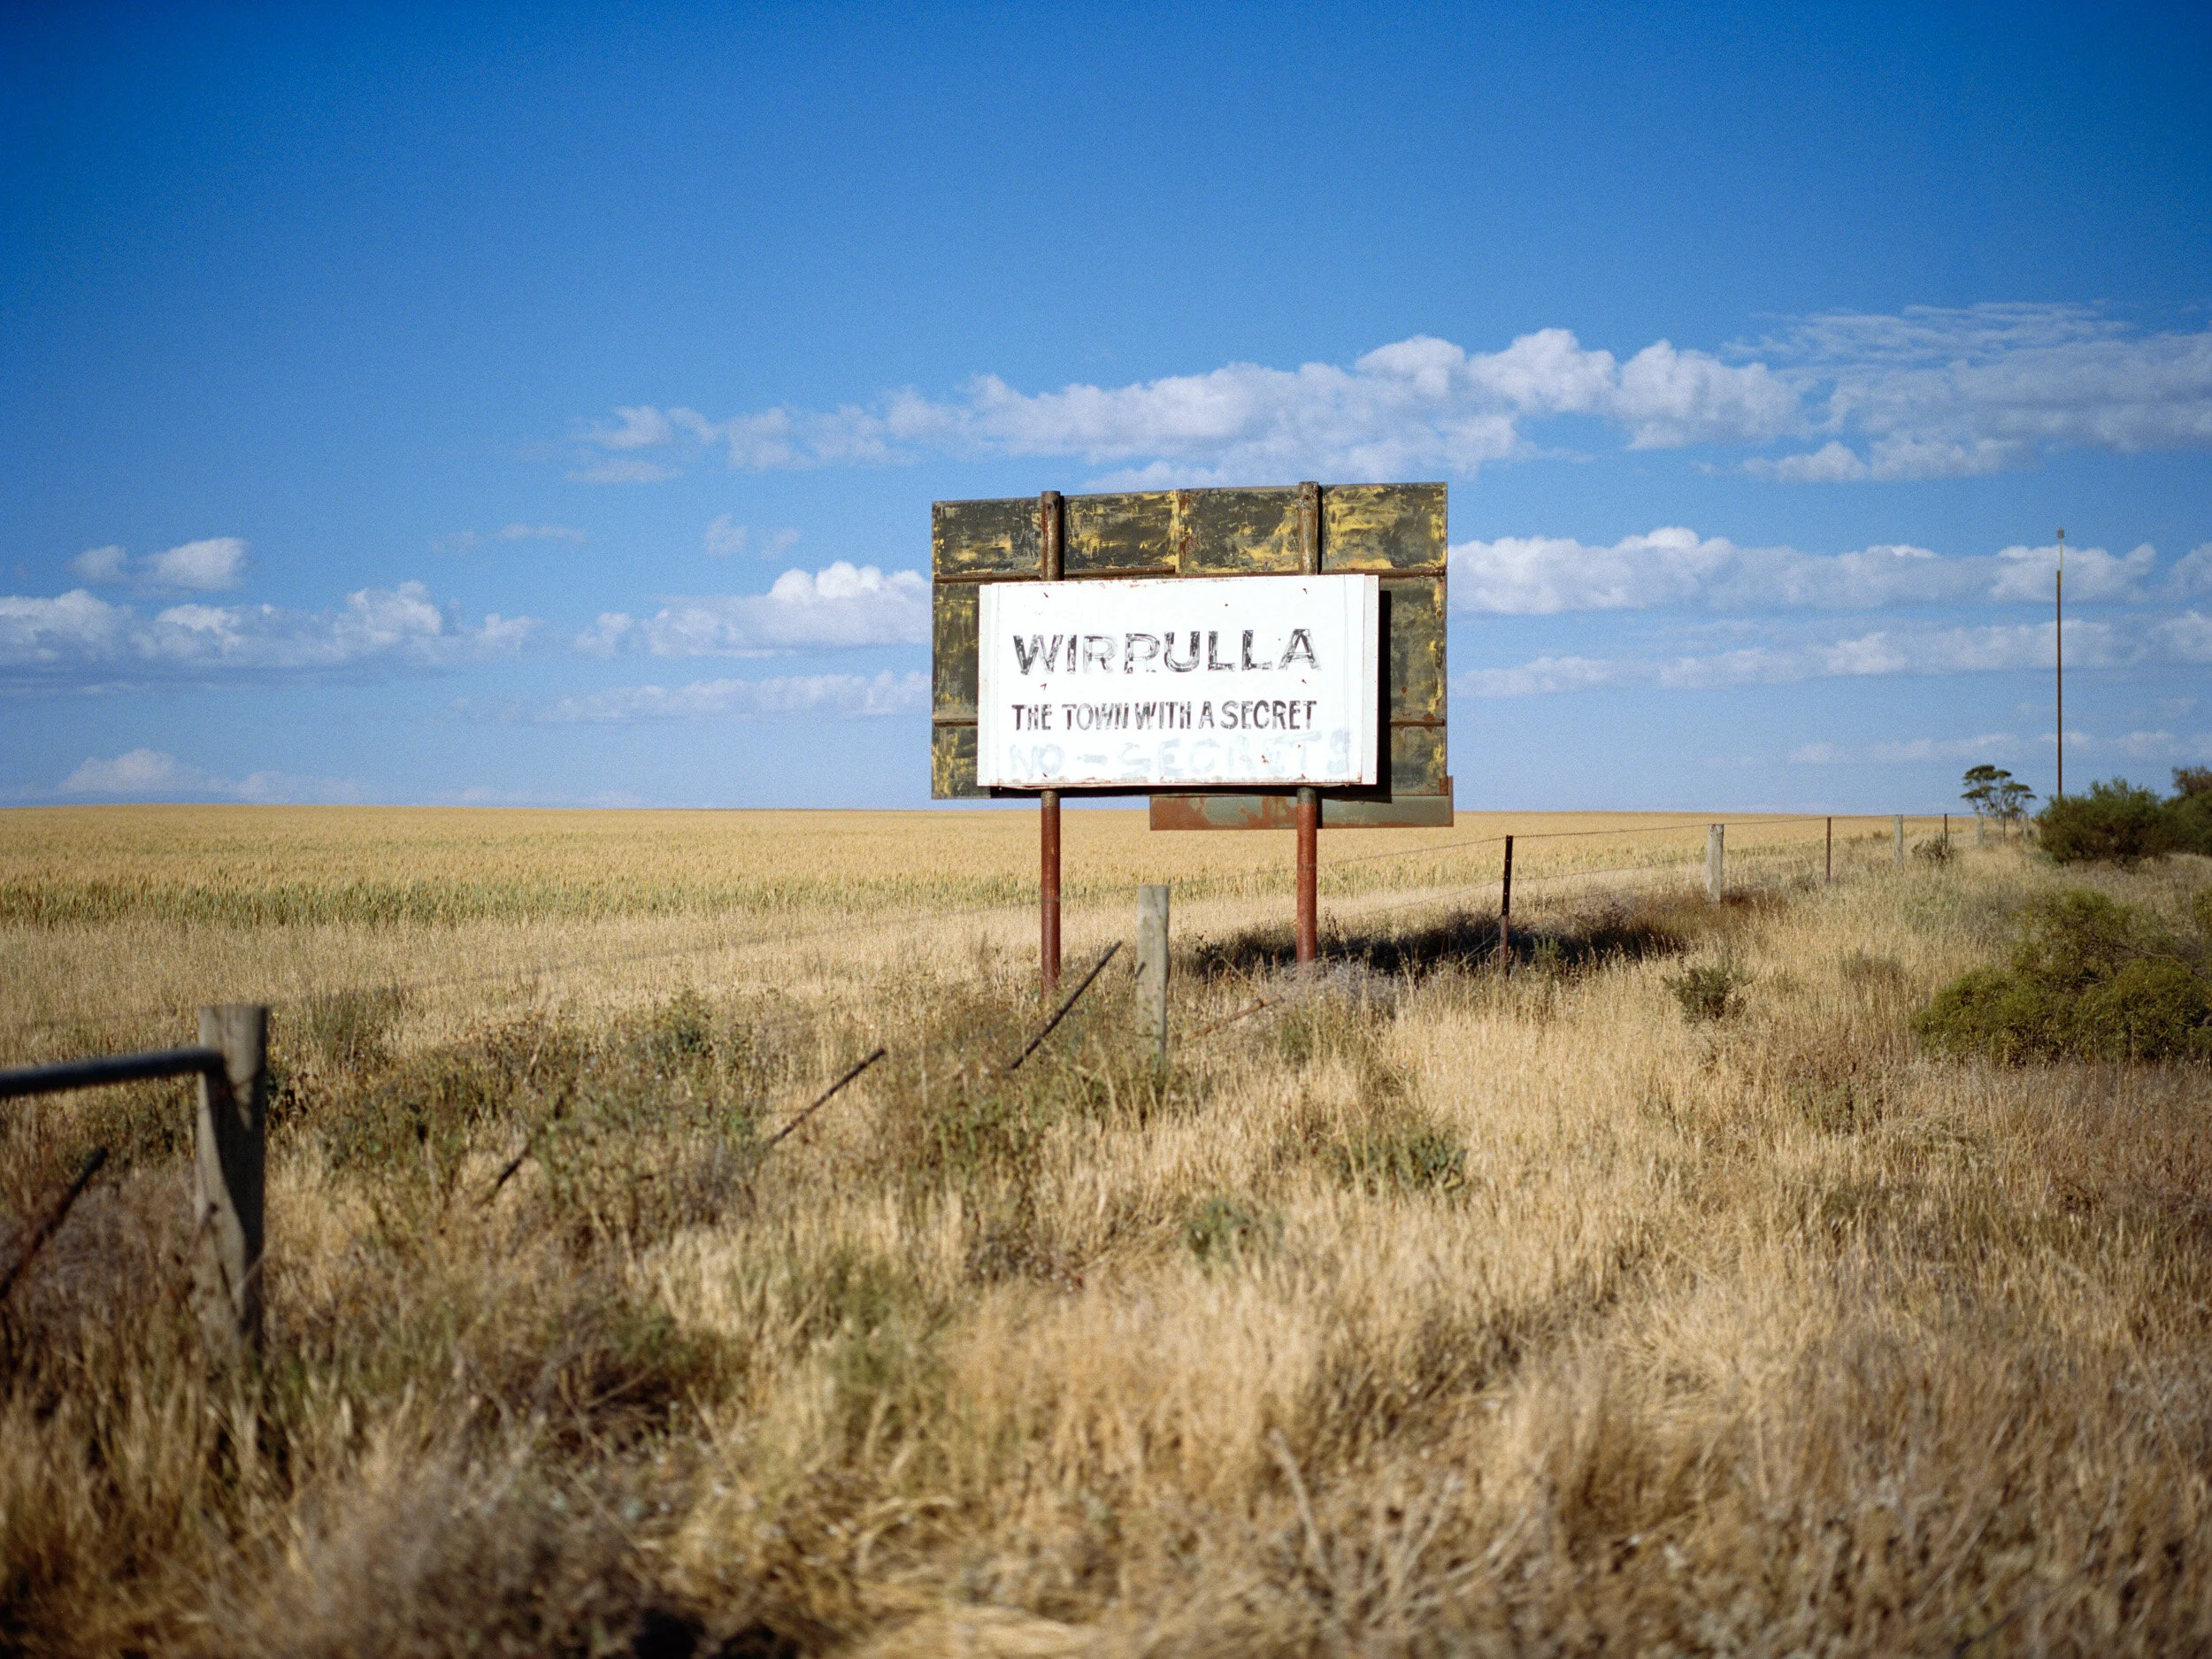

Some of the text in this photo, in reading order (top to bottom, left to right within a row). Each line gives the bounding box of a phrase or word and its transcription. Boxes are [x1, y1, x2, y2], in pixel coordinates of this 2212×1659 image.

[1011, 699, 1318, 731] THE TOWN WITH A SECRET
